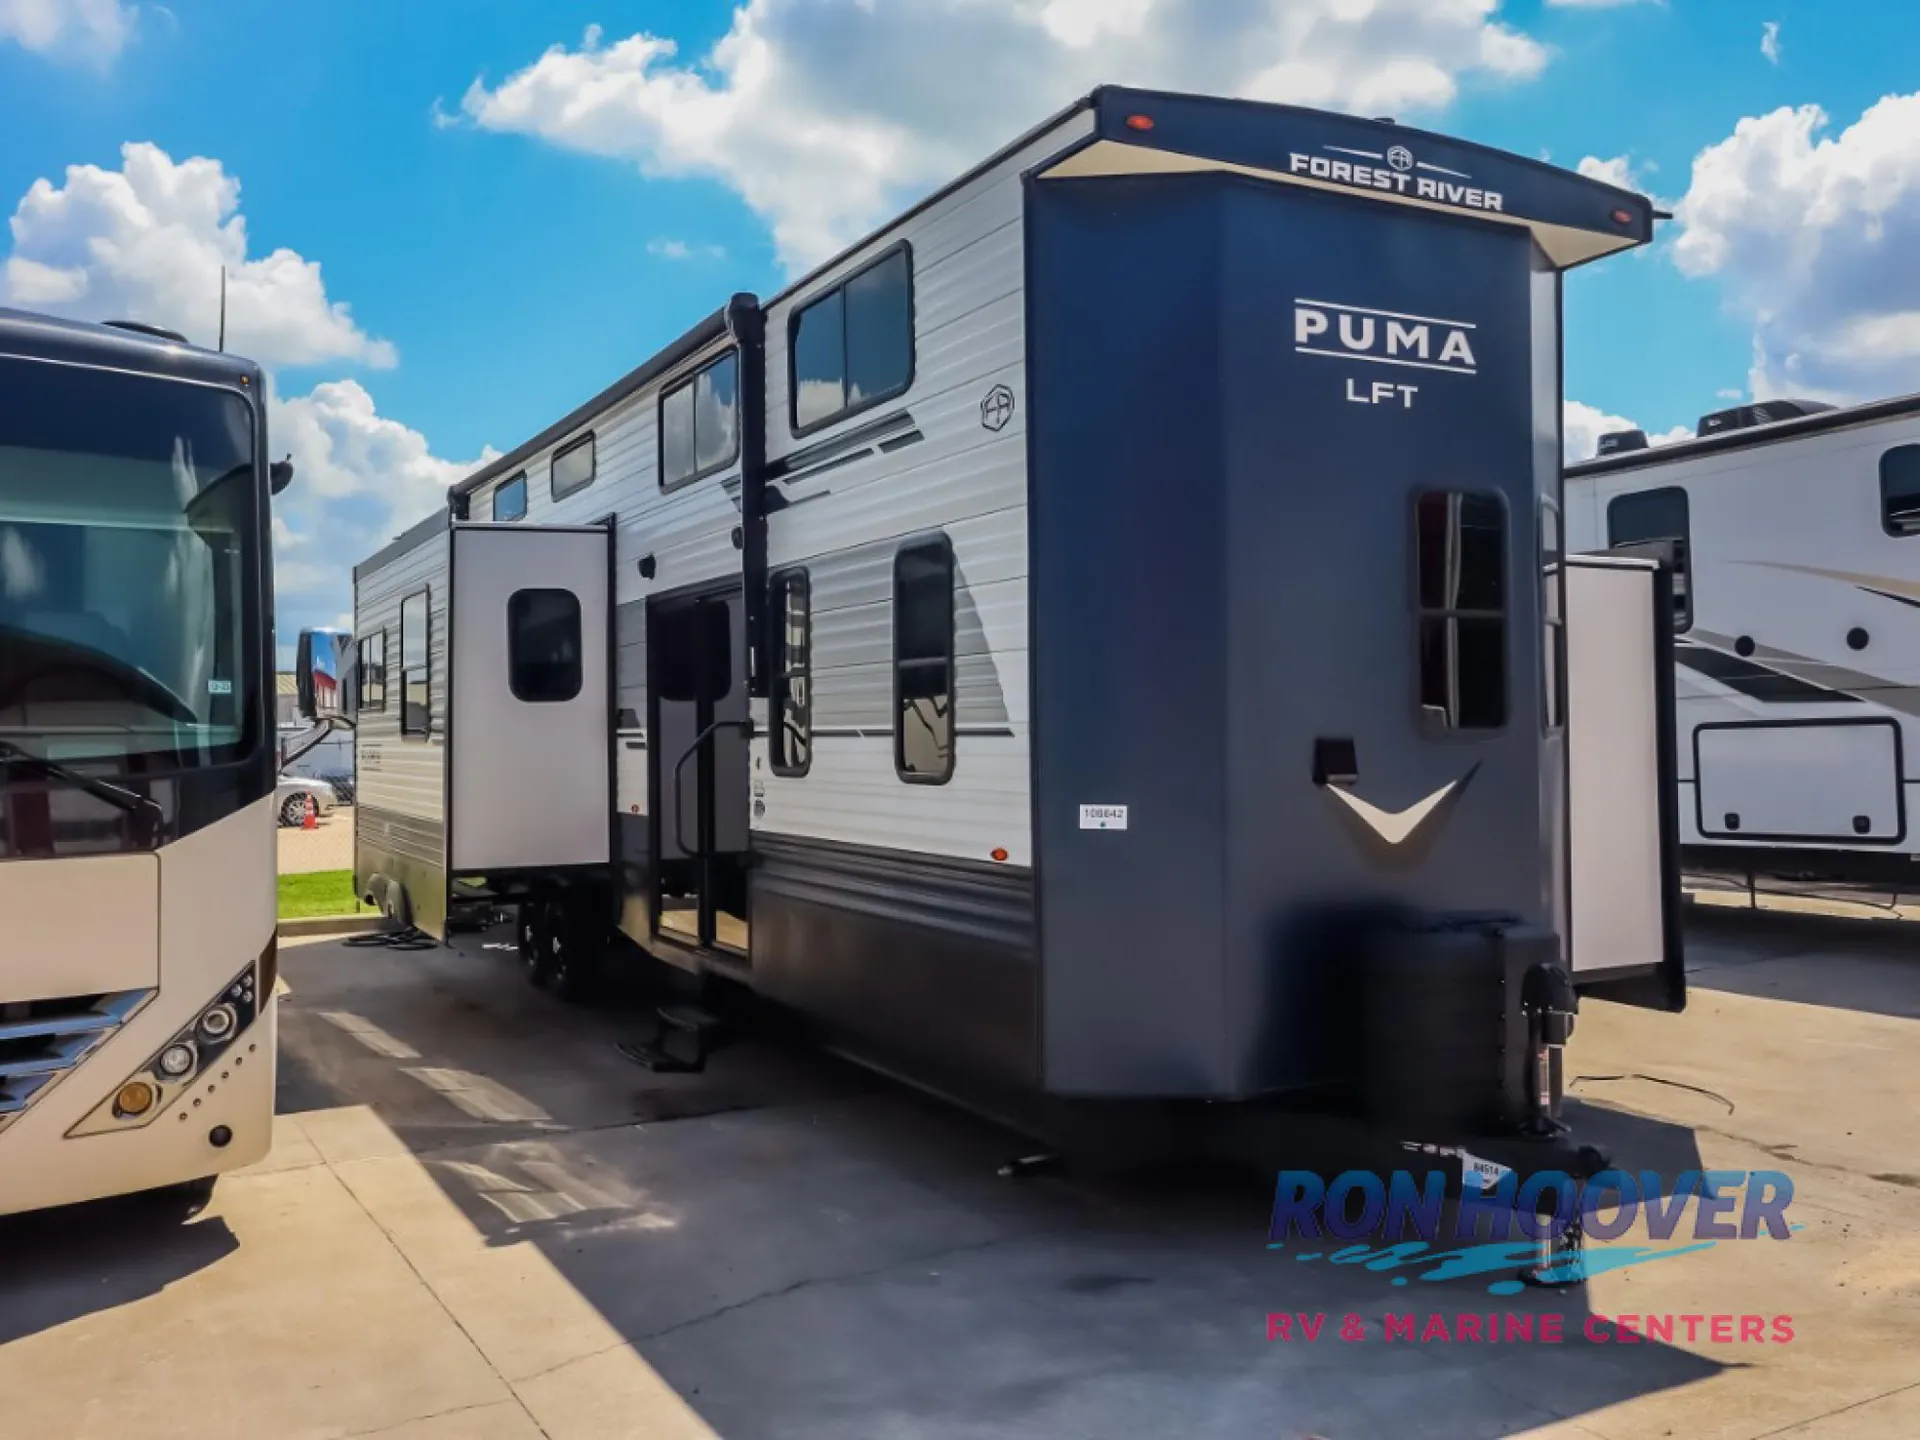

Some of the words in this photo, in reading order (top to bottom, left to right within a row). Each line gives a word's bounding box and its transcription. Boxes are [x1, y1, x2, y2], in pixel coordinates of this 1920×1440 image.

[1290, 153, 1411, 191] FOREST
[1416, 176, 1503, 211] RIVER
[1295, 308, 1476, 365] PUMA
[1346, 378, 1418, 408] LFT
